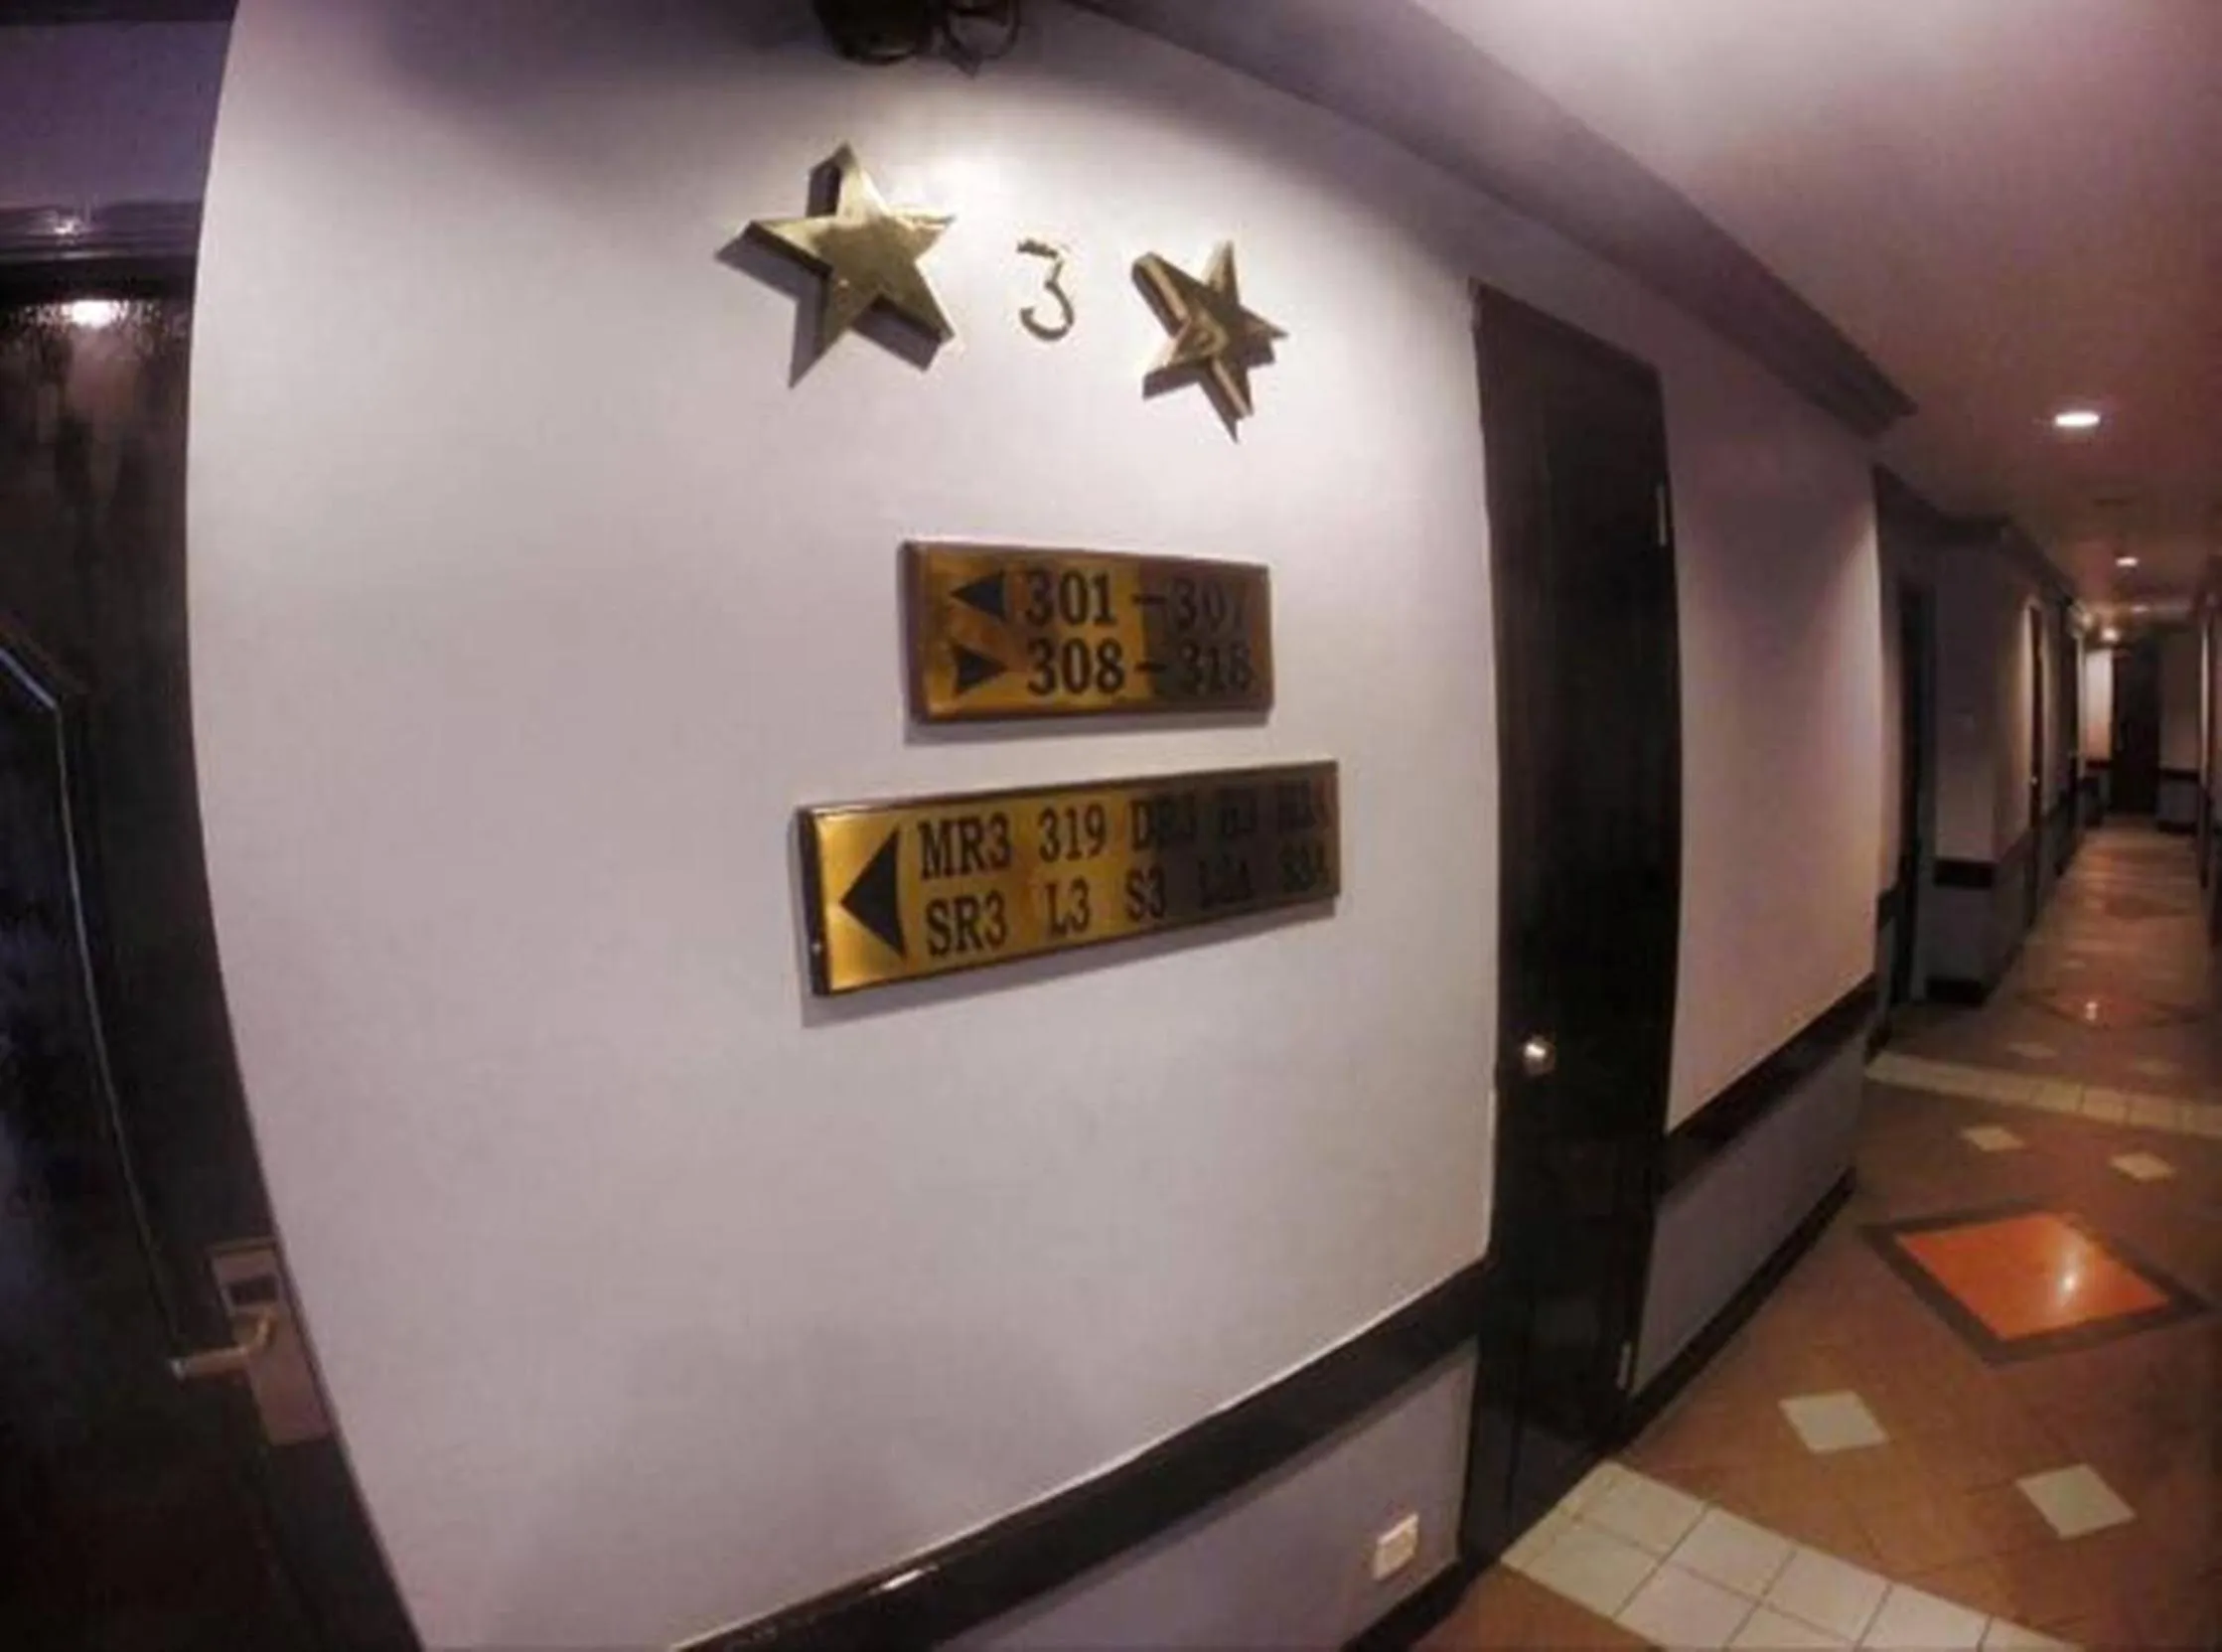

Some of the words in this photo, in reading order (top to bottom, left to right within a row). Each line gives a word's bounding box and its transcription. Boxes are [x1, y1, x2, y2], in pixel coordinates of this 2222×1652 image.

[1016, 237, 1075, 343] 3
[1024, 567, 1118, 626] 301
[1027, 637, 1125, 696] 308
[917, 812, 1011, 880] MR3
[1038, 799, 1108, 864] 319
[926, 896, 1009, 958] SR3
[1046, 879, 1092, 938] L3
[1124, 863, 1168, 922] S3
